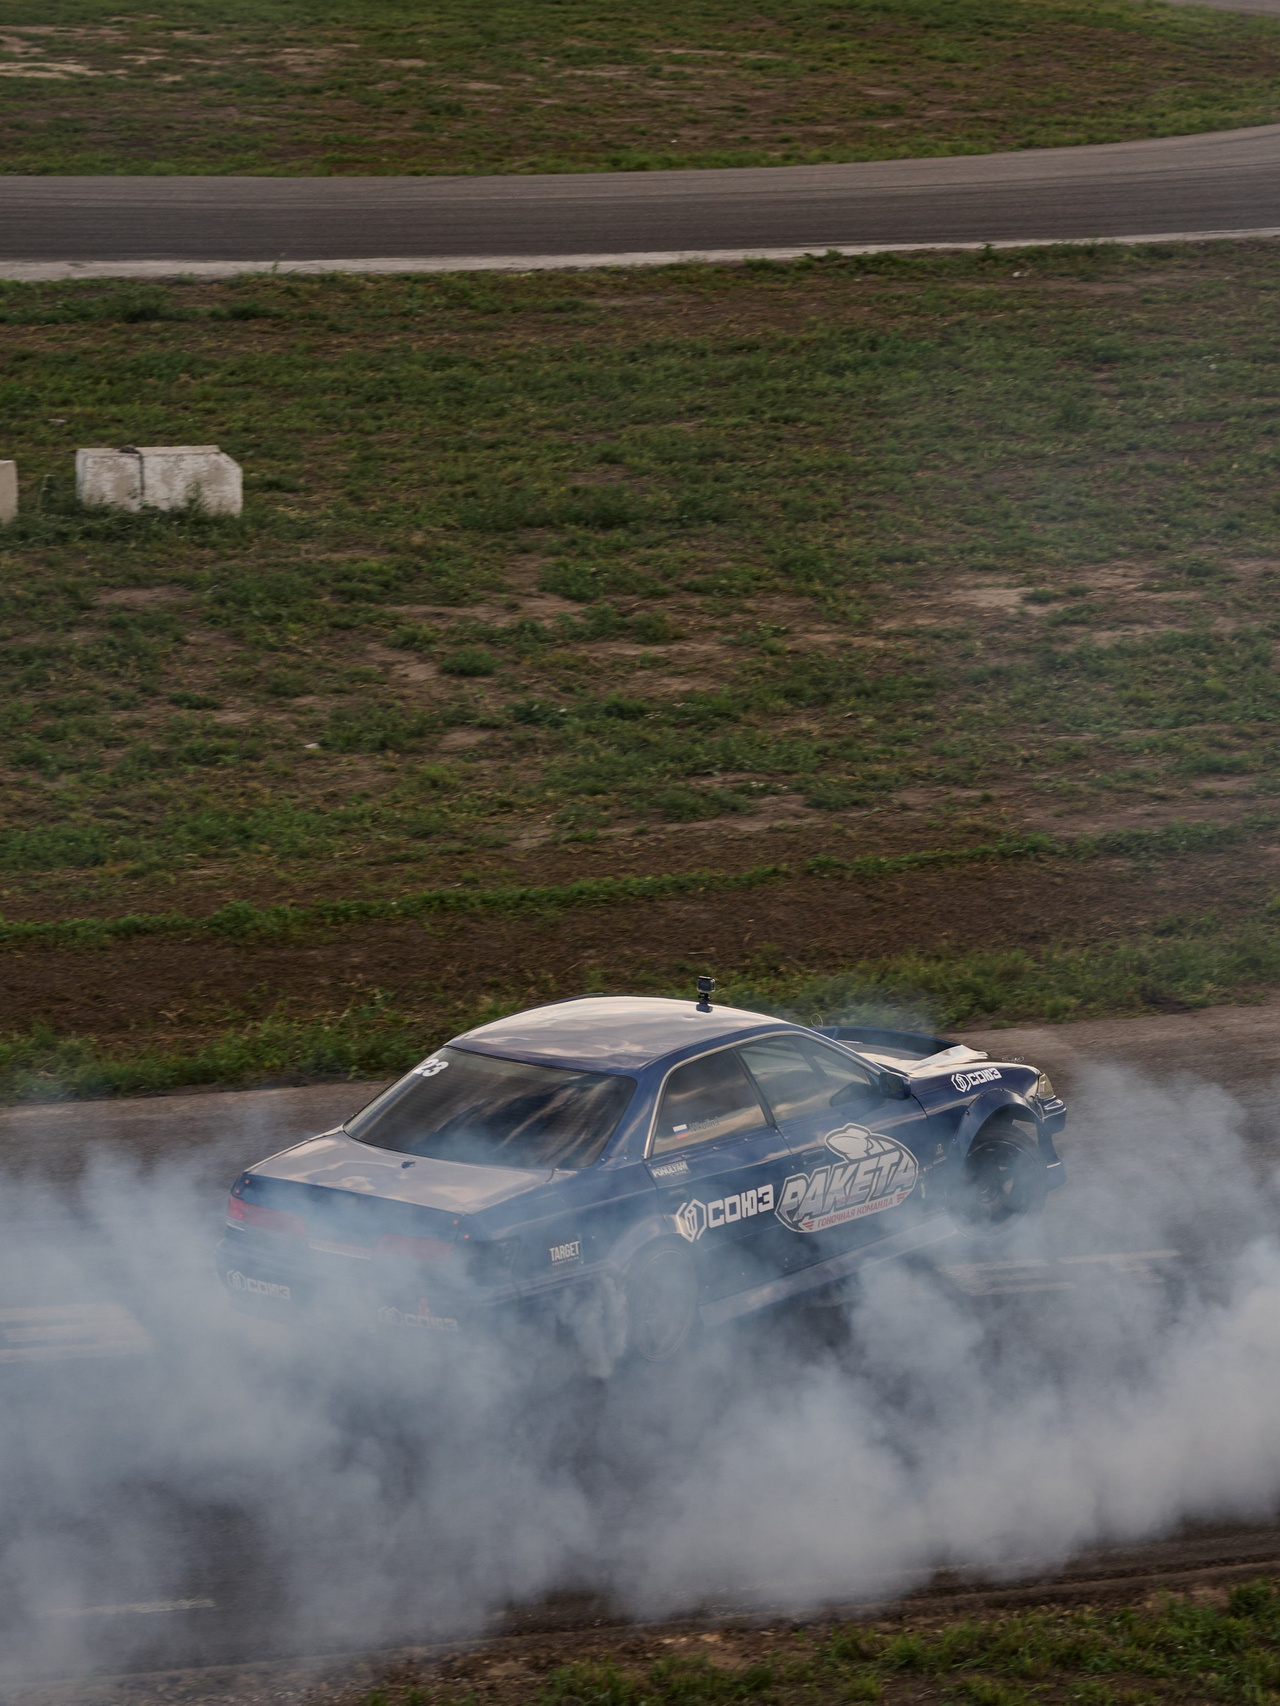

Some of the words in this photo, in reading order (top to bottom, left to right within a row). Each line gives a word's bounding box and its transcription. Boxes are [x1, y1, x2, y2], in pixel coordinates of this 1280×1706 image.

[412, 1058, 449, 1077] 23
[778, 1150, 917, 1223] РАКЕТА
[707, 1184, 775, 1229] СОЮЗ
[817, 1208, 856, 1228] ГОНОЧНАЯ
[857, 1199, 893, 1216] КОМАНДА
[549, 1240, 580, 1262] TARGET
